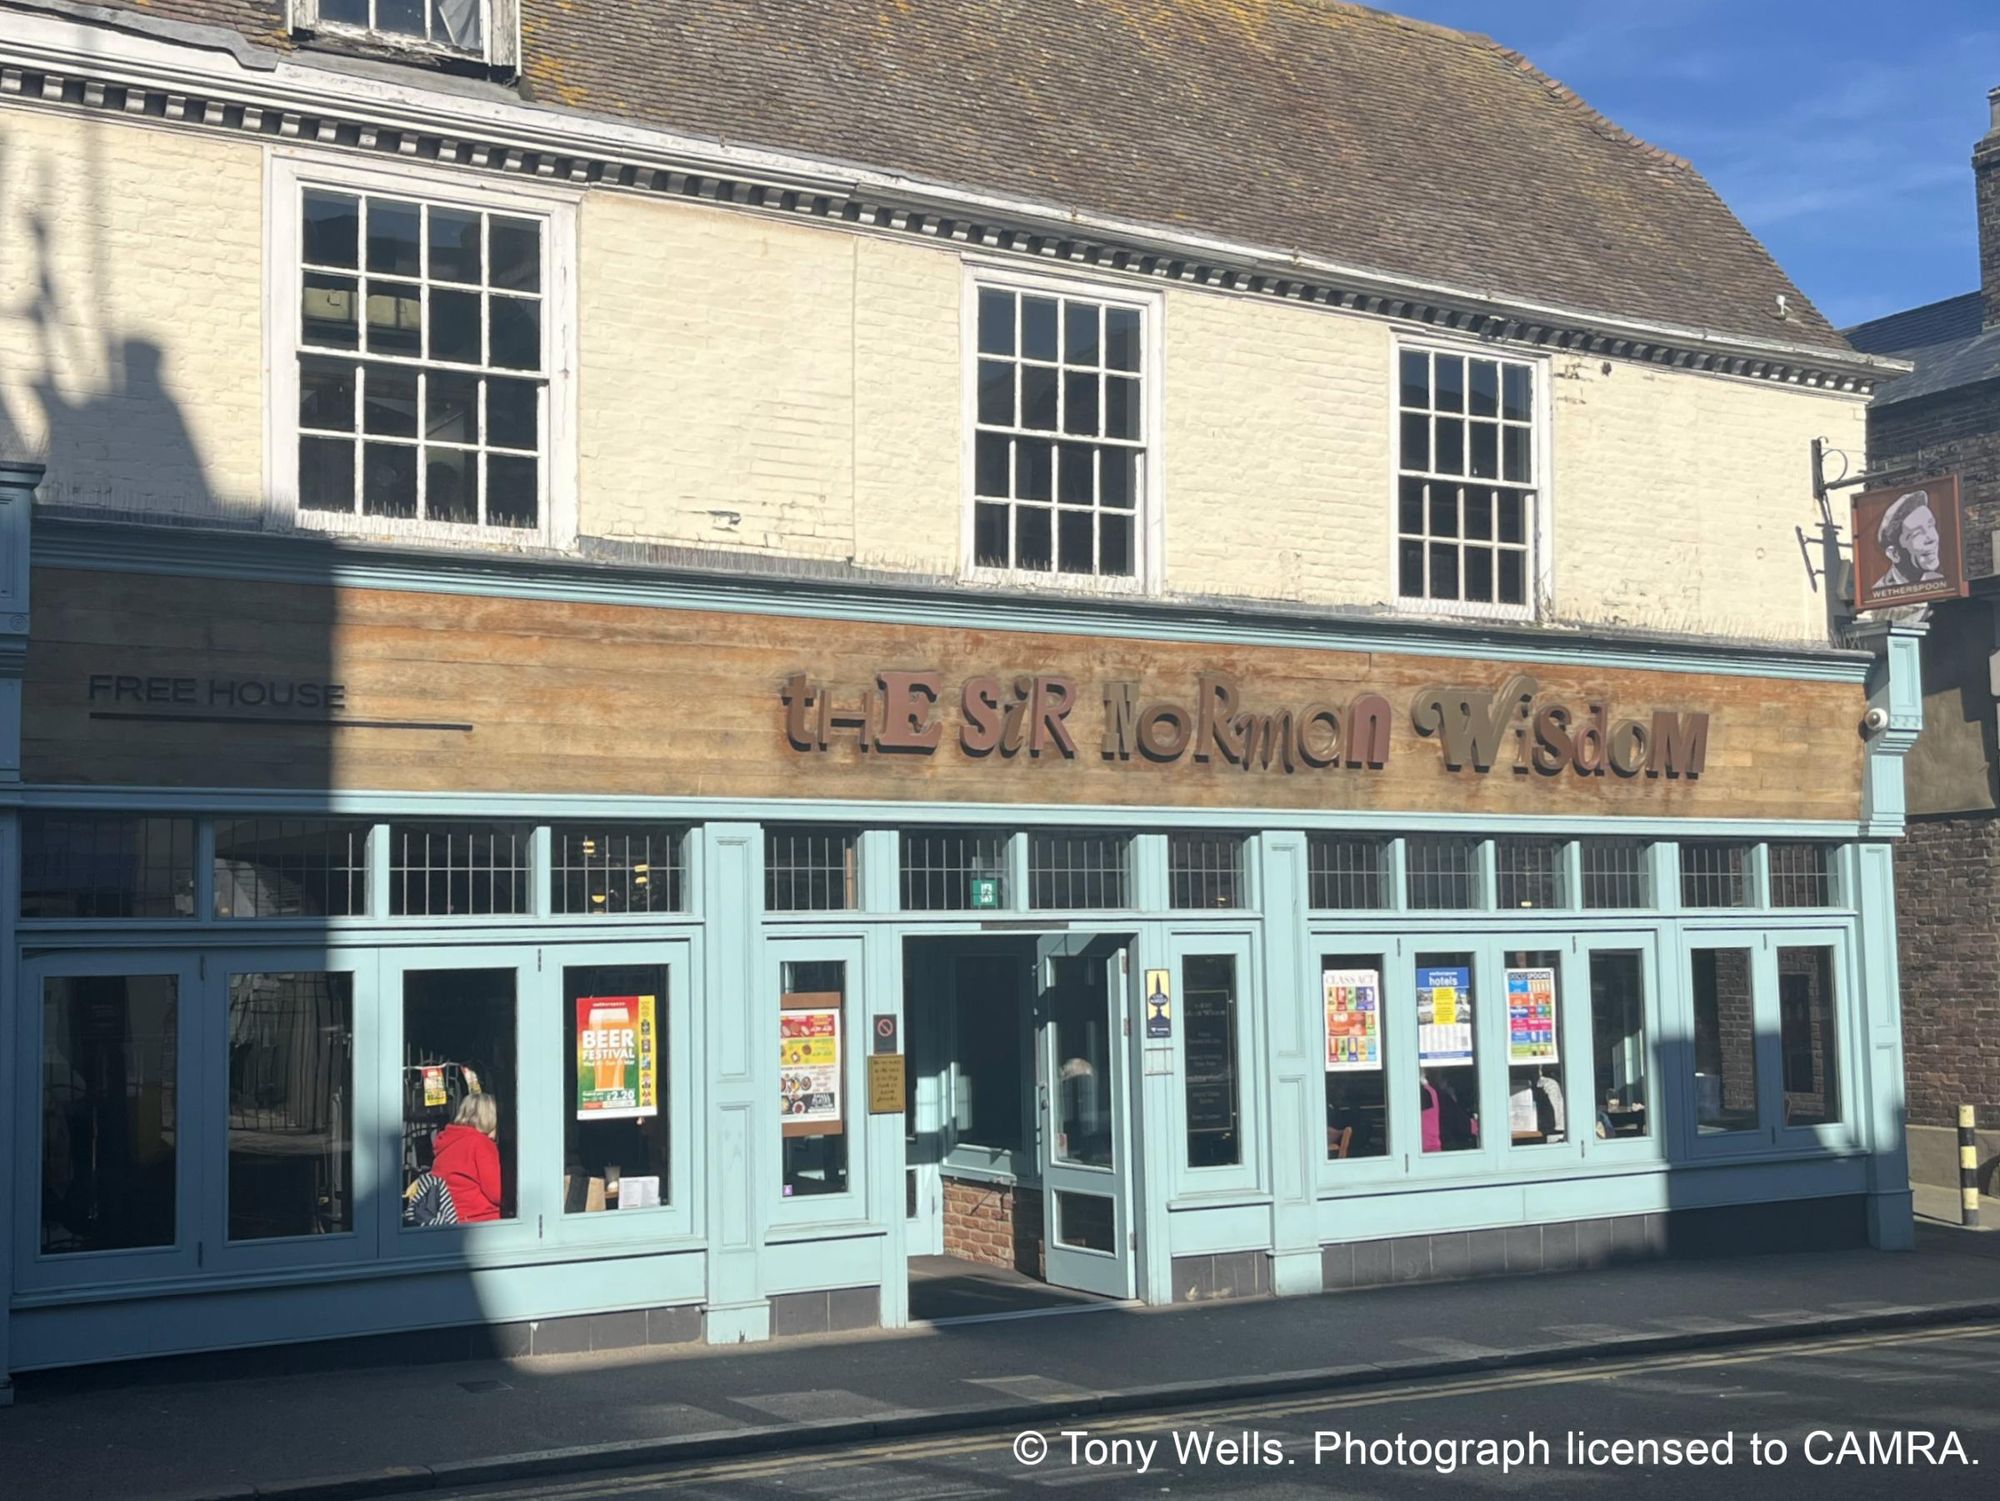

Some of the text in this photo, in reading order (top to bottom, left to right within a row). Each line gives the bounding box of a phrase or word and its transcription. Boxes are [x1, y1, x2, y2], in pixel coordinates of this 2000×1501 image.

[1872, 582, 1947, 598] WETHERSPOON
[89, 675, 346, 709] FREE HOUSE
[1429, 975, 1459, 987] hotels
[582, 1029, 635, 1049] BEER
[583, 1047, 636, 1061] FESTIVAL
